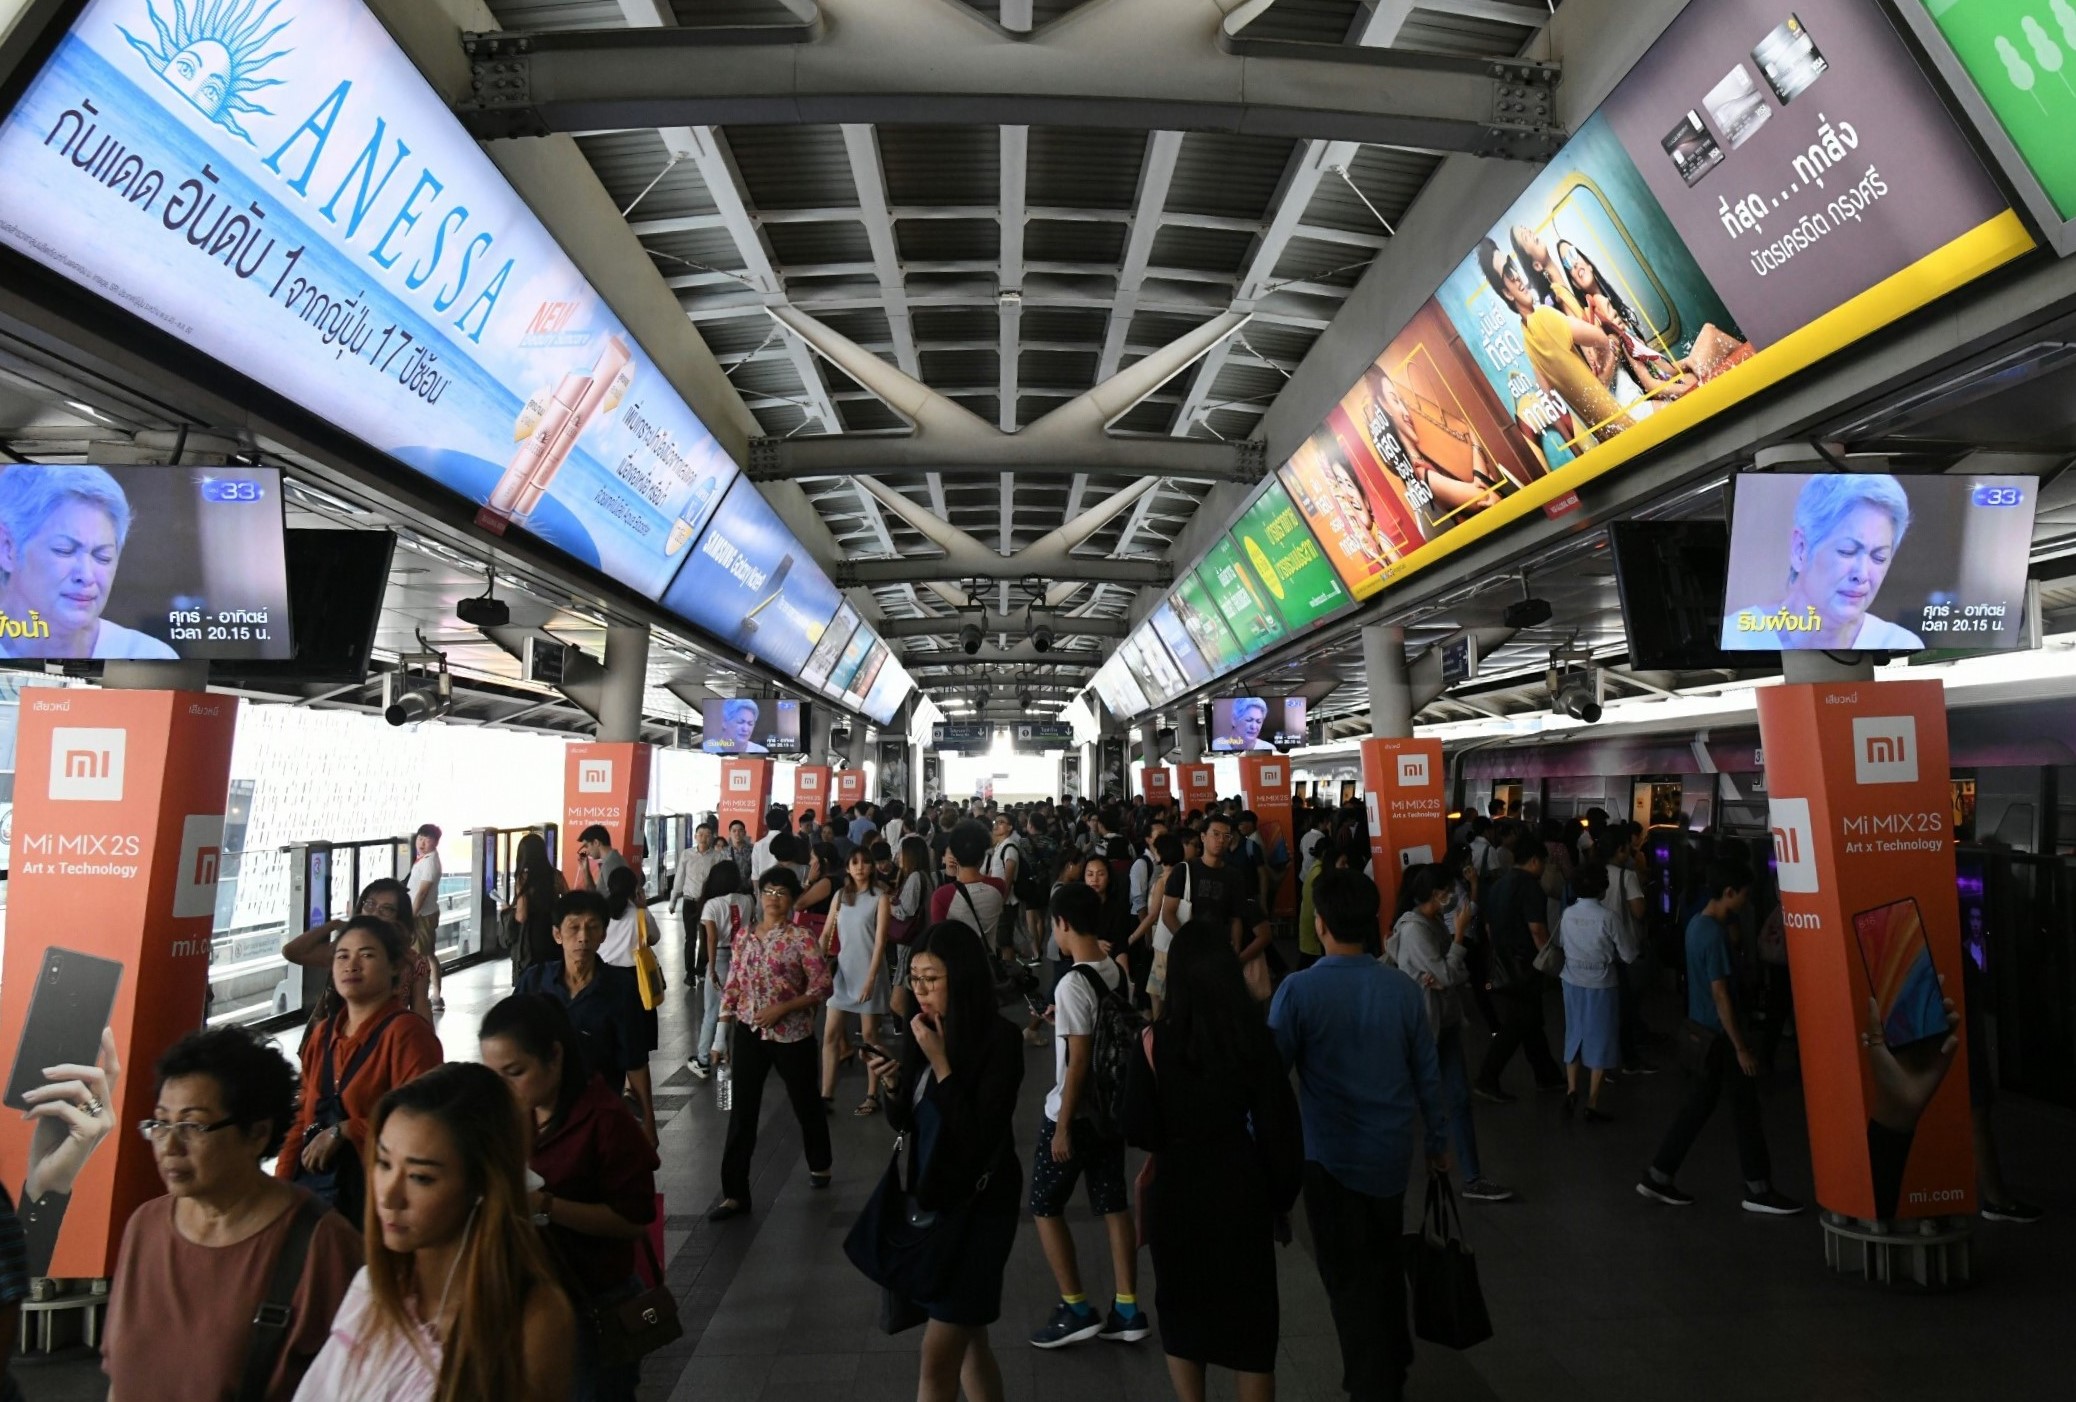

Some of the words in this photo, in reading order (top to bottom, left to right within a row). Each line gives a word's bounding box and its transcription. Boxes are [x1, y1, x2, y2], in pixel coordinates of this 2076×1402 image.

[43, 98, 164, 212] กันแดด
[163, 163, 276, 279] อันดับ
[260, 79, 515, 345] ANESSA
[1750, 212, 1831, 276] บัตรเครดิต
[1827, 164, 1888, 223] กรุงศรี
[268, 245, 305, 298] 1
[284, 277, 374, 359] จากญี่ปุ่น
[526, 302, 580, 334] NEW
[369, 324, 414, 373] 17
[1523, 383, 1568, 437] ทุกสิ่ง
[220, 483, 256, 500] 33
[1987, 489, 2017, 505] 33
[703, 530, 739, 569] SAMSUNG
[168, 606, 200, 628] ศุกร์
[218, 606, 268, 624] อาทิตย์
[1736, 606, 1822, 632] ริมฝั่งน้ำ
[1923, 601, 1951, 620] ศุกร์
[1964, 601, 2007, 617] อาทิตย์
[170, 627, 201, 641] เวลา
[208, 627, 251, 641] 20.15
[256, 628, 271, 641] น.
[1922, 619, 1948, 632] เวลา
[1952, 619, 1988, 632] 20.15
[1992, 620, 2005, 632] น.
[568, 807, 582, 816] Mi
[584, 807, 606, 817] MIX
[607, 807, 620, 817] 2S
[1391, 800, 1405, 810] Mi
[1406, 799, 1427, 810] MIX
[1427, 799, 1440, 809] 2S
[1407, 811, 1440, 819] Technology
[1843, 815, 1868, 835] Mi
[1873, 813, 1915, 834] MIX
[1917, 812, 1942, 832] 2S
[23, 834, 53, 855] Mi
[58, 834, 107, 856] MIX
[110, 834, 140, 856] 2S
[1846, 841, 1863, 853] Art
[1866, 843, 1873, 852] x
[1876, 839, 1943, 852] Technology
[22, 862, 44, 875] Art
[46, 865, 55, 875] x
[59, 862, 137, 878] Technology
[1909, 1188, 1965, 1203] mi.com
